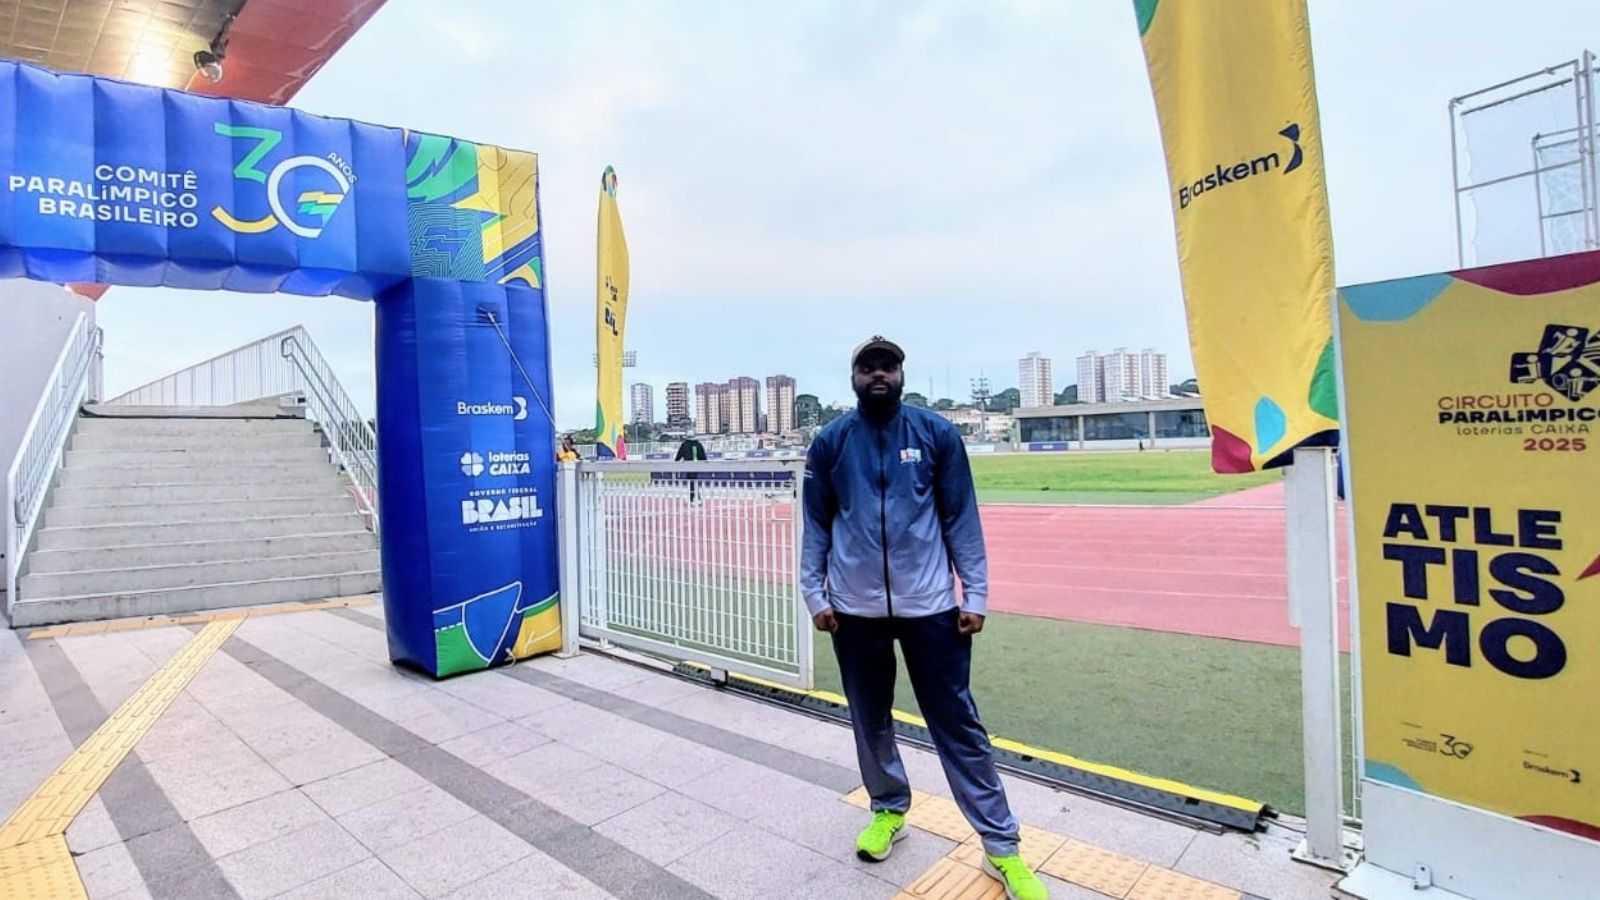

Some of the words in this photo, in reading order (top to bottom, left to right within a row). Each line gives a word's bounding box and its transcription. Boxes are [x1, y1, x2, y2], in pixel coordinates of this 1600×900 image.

[95, 164, 198, 190] COMITÊ
[327, 152, 358, 184] ANOS
[1179, 152, 1280, 209] Braskem
[39, 197, 198, 228] BRASILEIRO
[457, 401, 513, 415] Braskem
[1438, 393, 1554, 410] CIRCUITO
[1457, 425, 1523, 436] loterias
[1531, 423, 1589, 435] CAIXA
[488, 450, 530, 463] loterias
[1523, 438, 1587, 451] 2025
[489, 463, 531, 476] CAIXA
[462, 495, 543, 525] BRASIL
[1383, 503, 1563, 550] ATLE
[1383, 543, 1565, 615] TIS
[1386, 602, 1567, 680] MO
